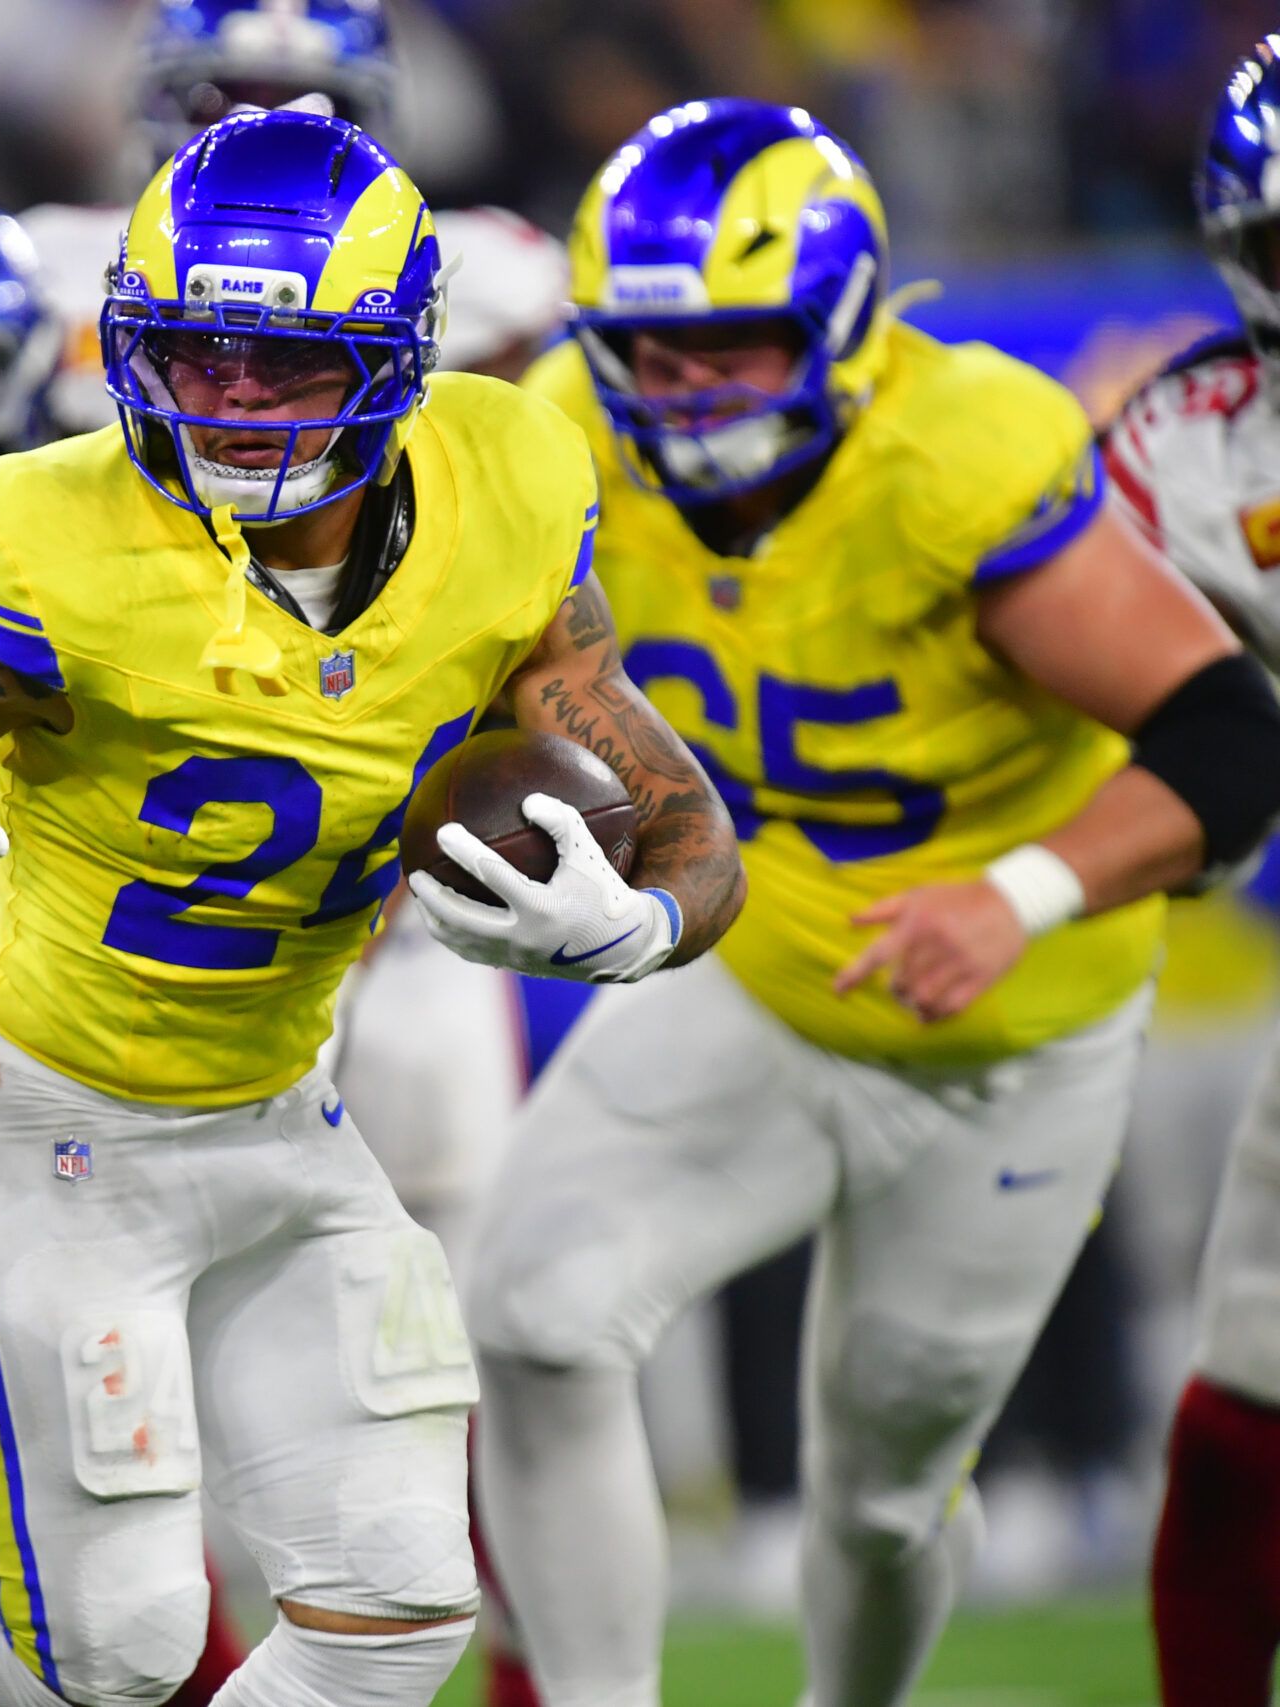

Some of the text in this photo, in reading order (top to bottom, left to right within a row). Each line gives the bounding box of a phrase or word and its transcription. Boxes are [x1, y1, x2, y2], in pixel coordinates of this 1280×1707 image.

[221, 278, 265, 294] RAMS
[355, 306, 398, 315] OAKLEY
[326, 670, 353, 692] NFL
[60, 1156, 89, 1175] NFL
